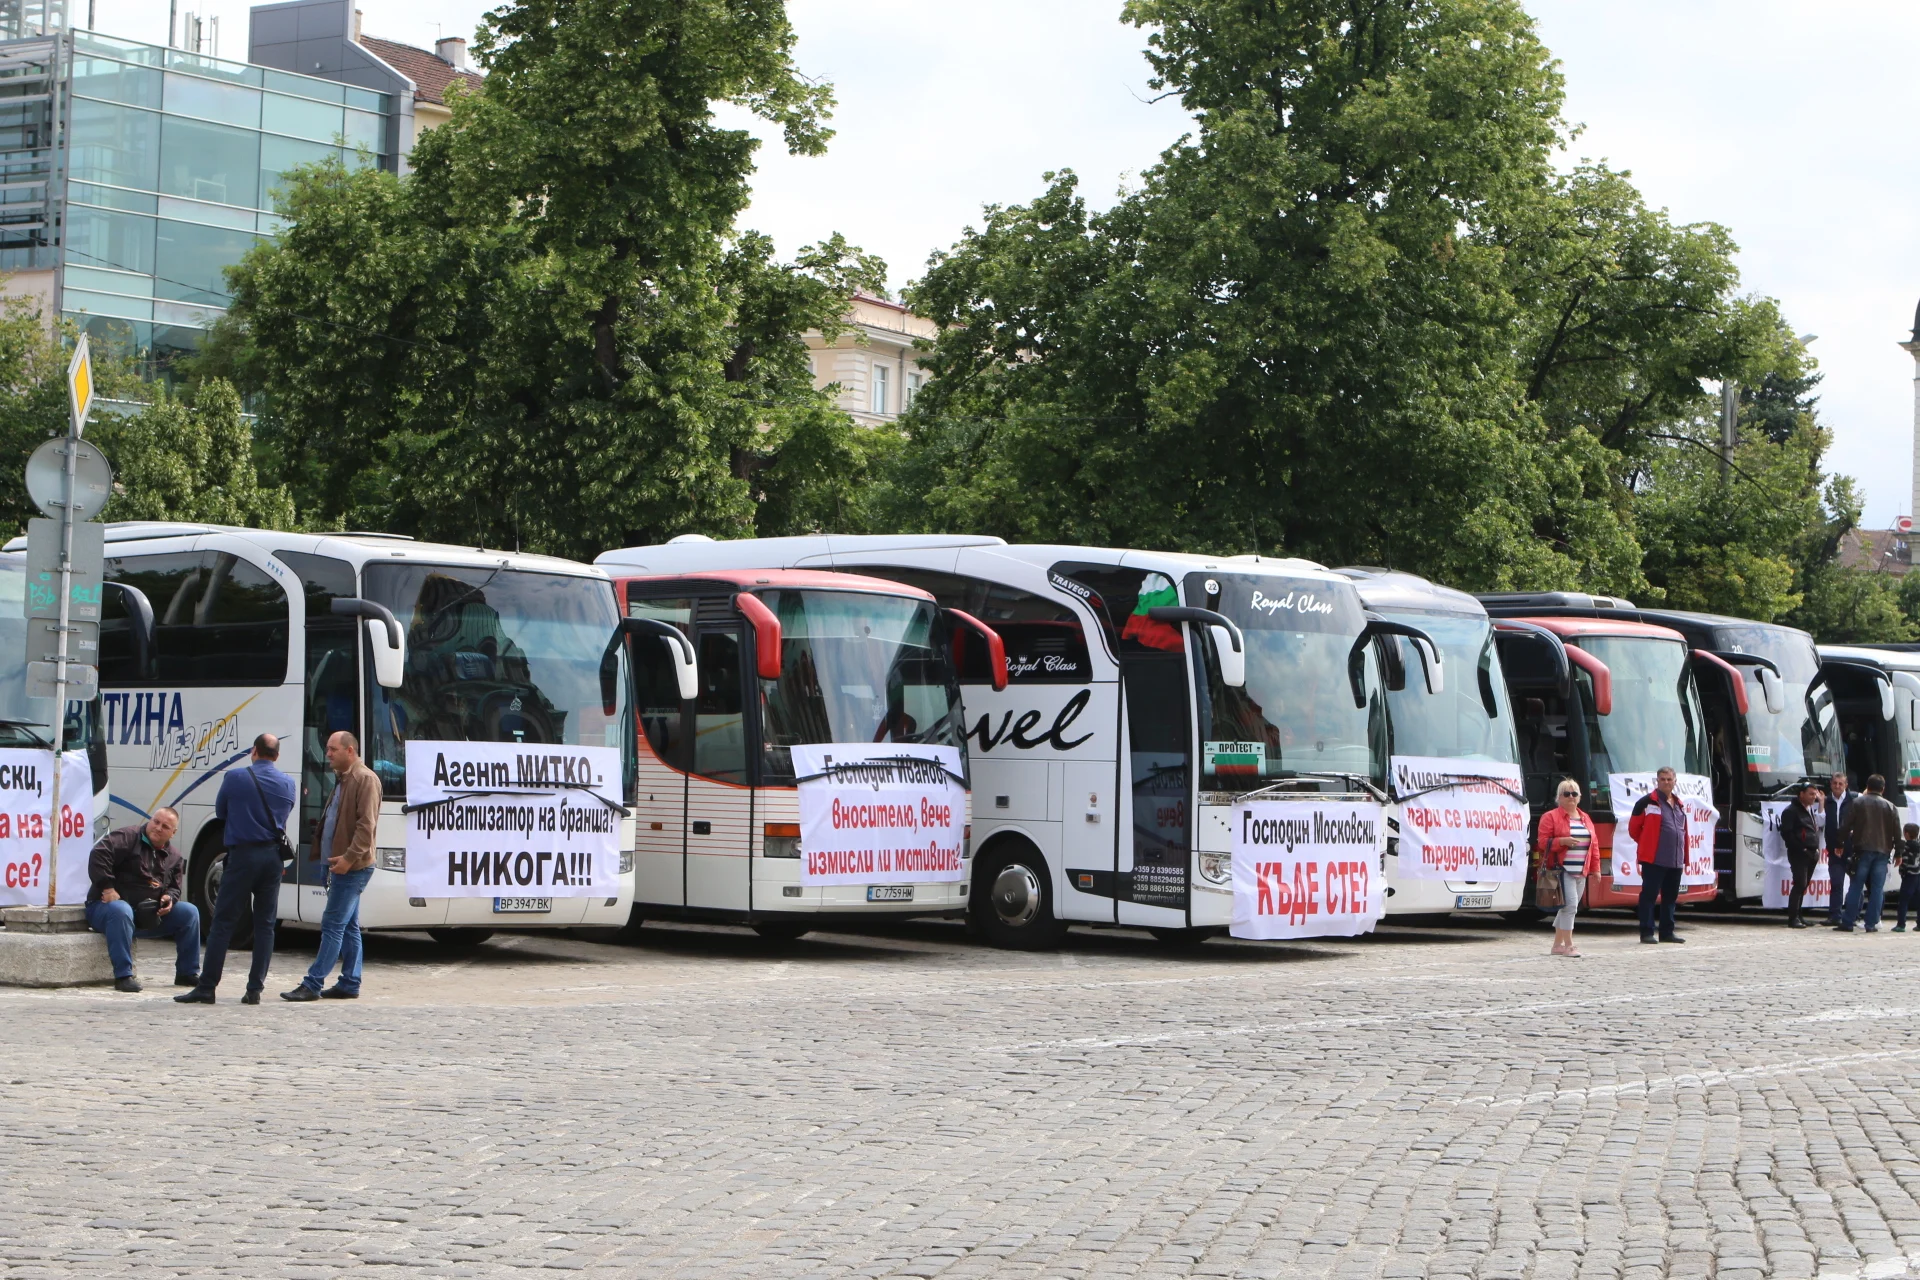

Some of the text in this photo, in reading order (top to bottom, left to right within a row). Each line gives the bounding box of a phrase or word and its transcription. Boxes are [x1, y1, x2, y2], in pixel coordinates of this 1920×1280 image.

[1052, 574, 1090, 598] TRAVEGO
[1207, 583, 1217, 591] 22
[1251, 590, 1333, 616] Royal Class
[1731, 645, 1742, 653] 20
[1004, 655, 1077, 677] Royal Class
[149, 714, 238, 771] МЕЗДРА
[1219, 743, 1253, 753] ПРОТЕСТ
[0, 764, 42, 799] ски,
[433, 752, 510, 787] Агент
[516, 754, 591, 789] МИТКО
[823, 754, 949, 792] Господин Иванов,
[17, 813, 43, 839] на
[417, 796, 616, 840] приватизатор на бранша?
[832, 796, 951, 834] вносителю, вече
[1407, 805, 1523, 837] пари се изкарват
[1243, 810, 1376, 853] Господин Московски,
[5, 853, 42, 888] се?
[448, 851, 592, 887] НИКОГА!!!
[808, 849, 874, 876] измисли
[877, 849, 891, 873] ли
[1422, 841, 1515, 872] трудно, нали?
[1621, 862, 1631, 876] е
[1255, 861, 1368, 926] КЪДЕ СТЕ?
